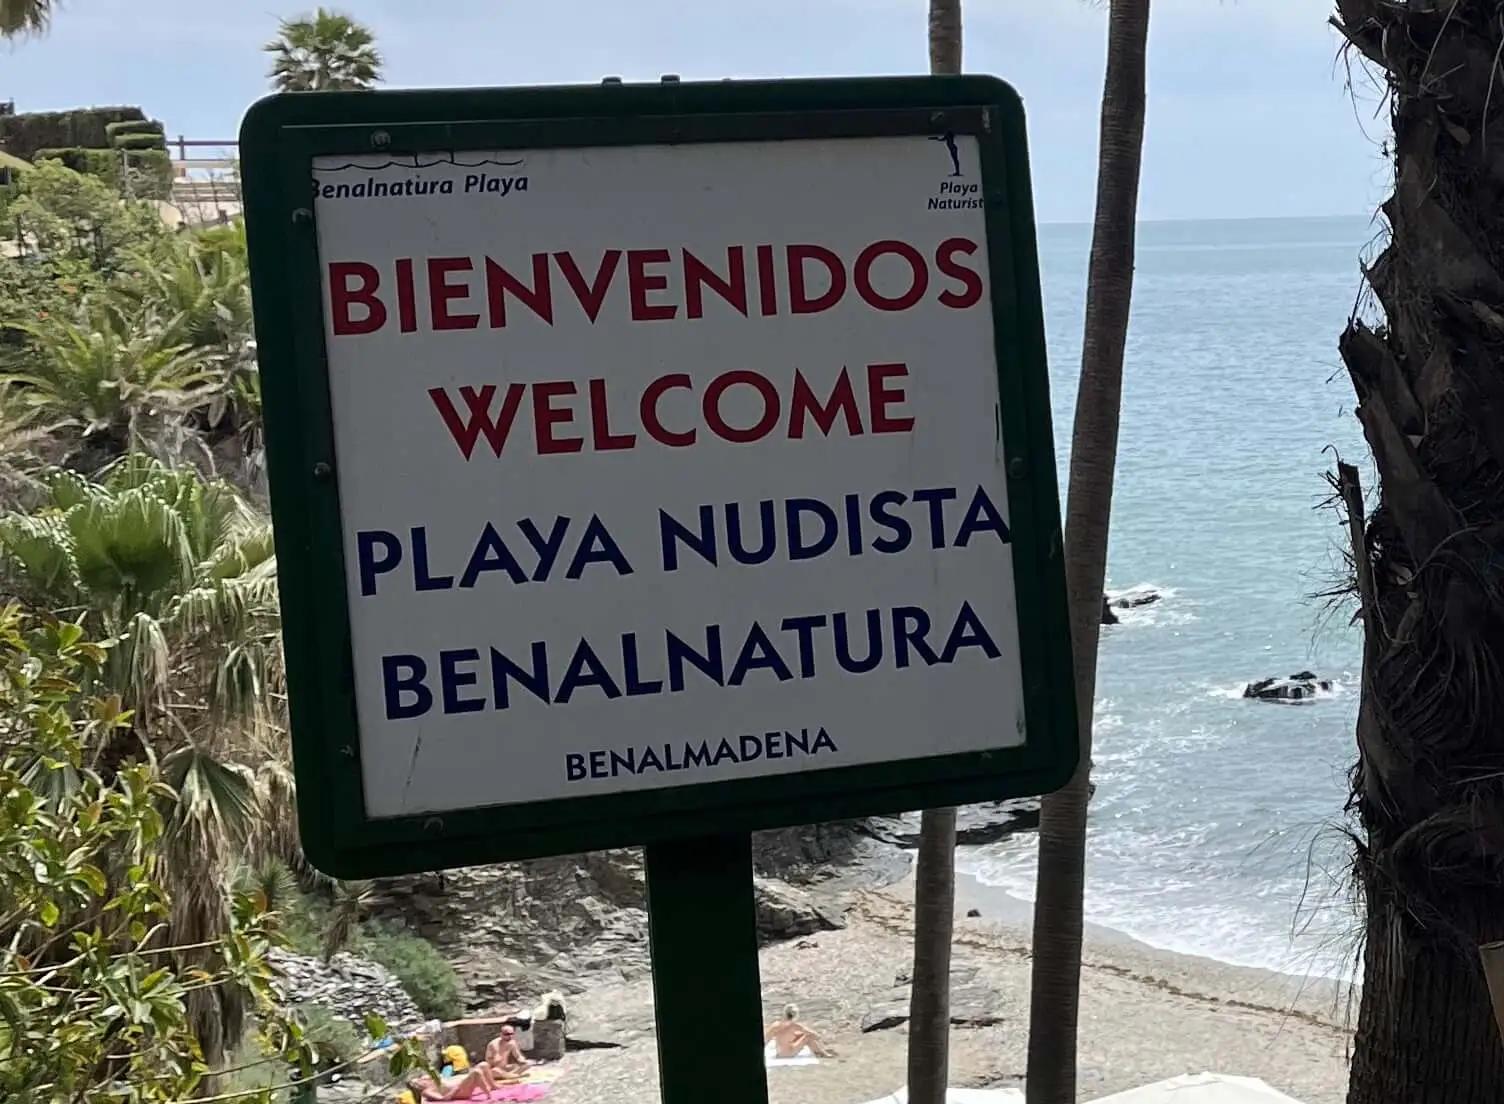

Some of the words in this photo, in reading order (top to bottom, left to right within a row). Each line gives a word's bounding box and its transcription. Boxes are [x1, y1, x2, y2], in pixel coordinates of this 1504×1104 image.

[464, 173, 529, 197] Playa
[939, 181, 978, 196] Playa
[329, 238, 983, 336] BIENVENIDOS
[428, 363, 915, 460] WELCOME
[357, 512, 634, 596] PLAYA
[659, 485, 1012, 572] NUDISTA
[382, 601, 1002, 719] BENALNATURA
[565, 727, 838, 780] BENALMADENA
